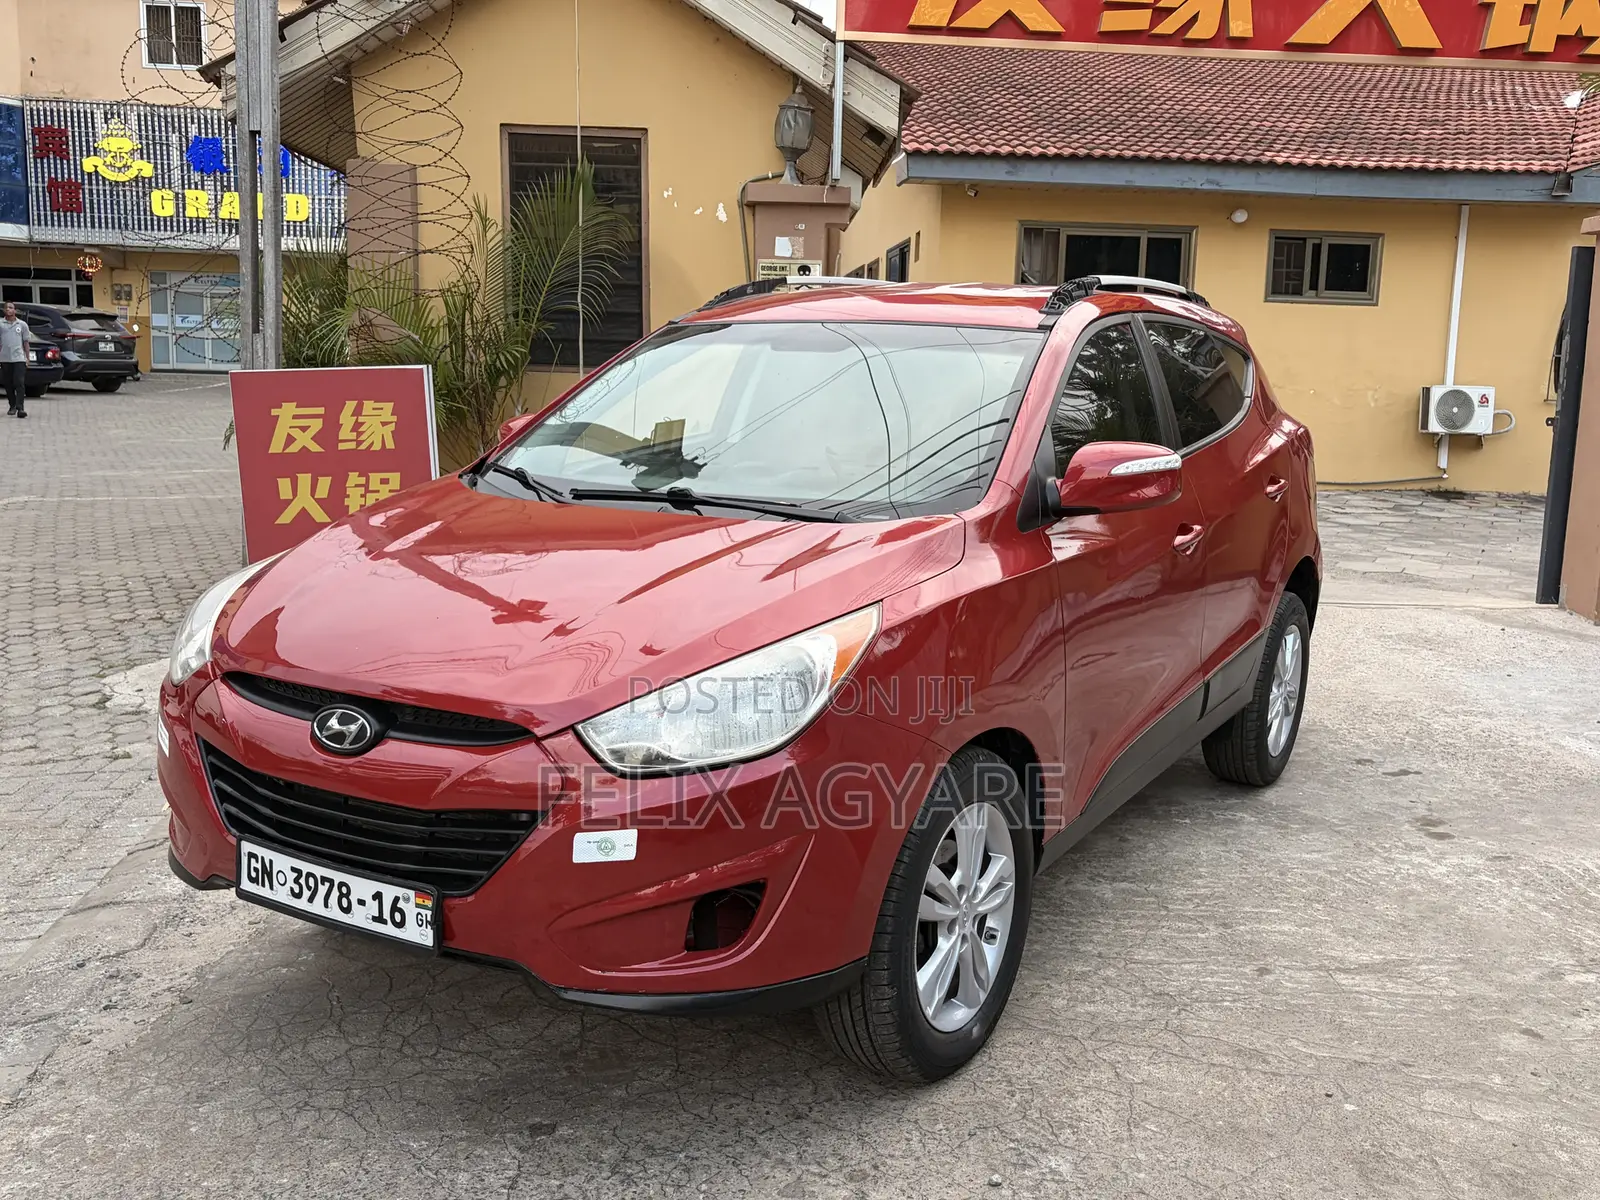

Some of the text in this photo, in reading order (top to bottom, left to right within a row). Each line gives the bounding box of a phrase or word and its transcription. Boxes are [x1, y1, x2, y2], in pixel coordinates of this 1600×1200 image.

[151, 188, 309, 222] GRAD
[268, 400, 397, 454] 友缘
[246, 850, 407, 930] GN 3978-16
